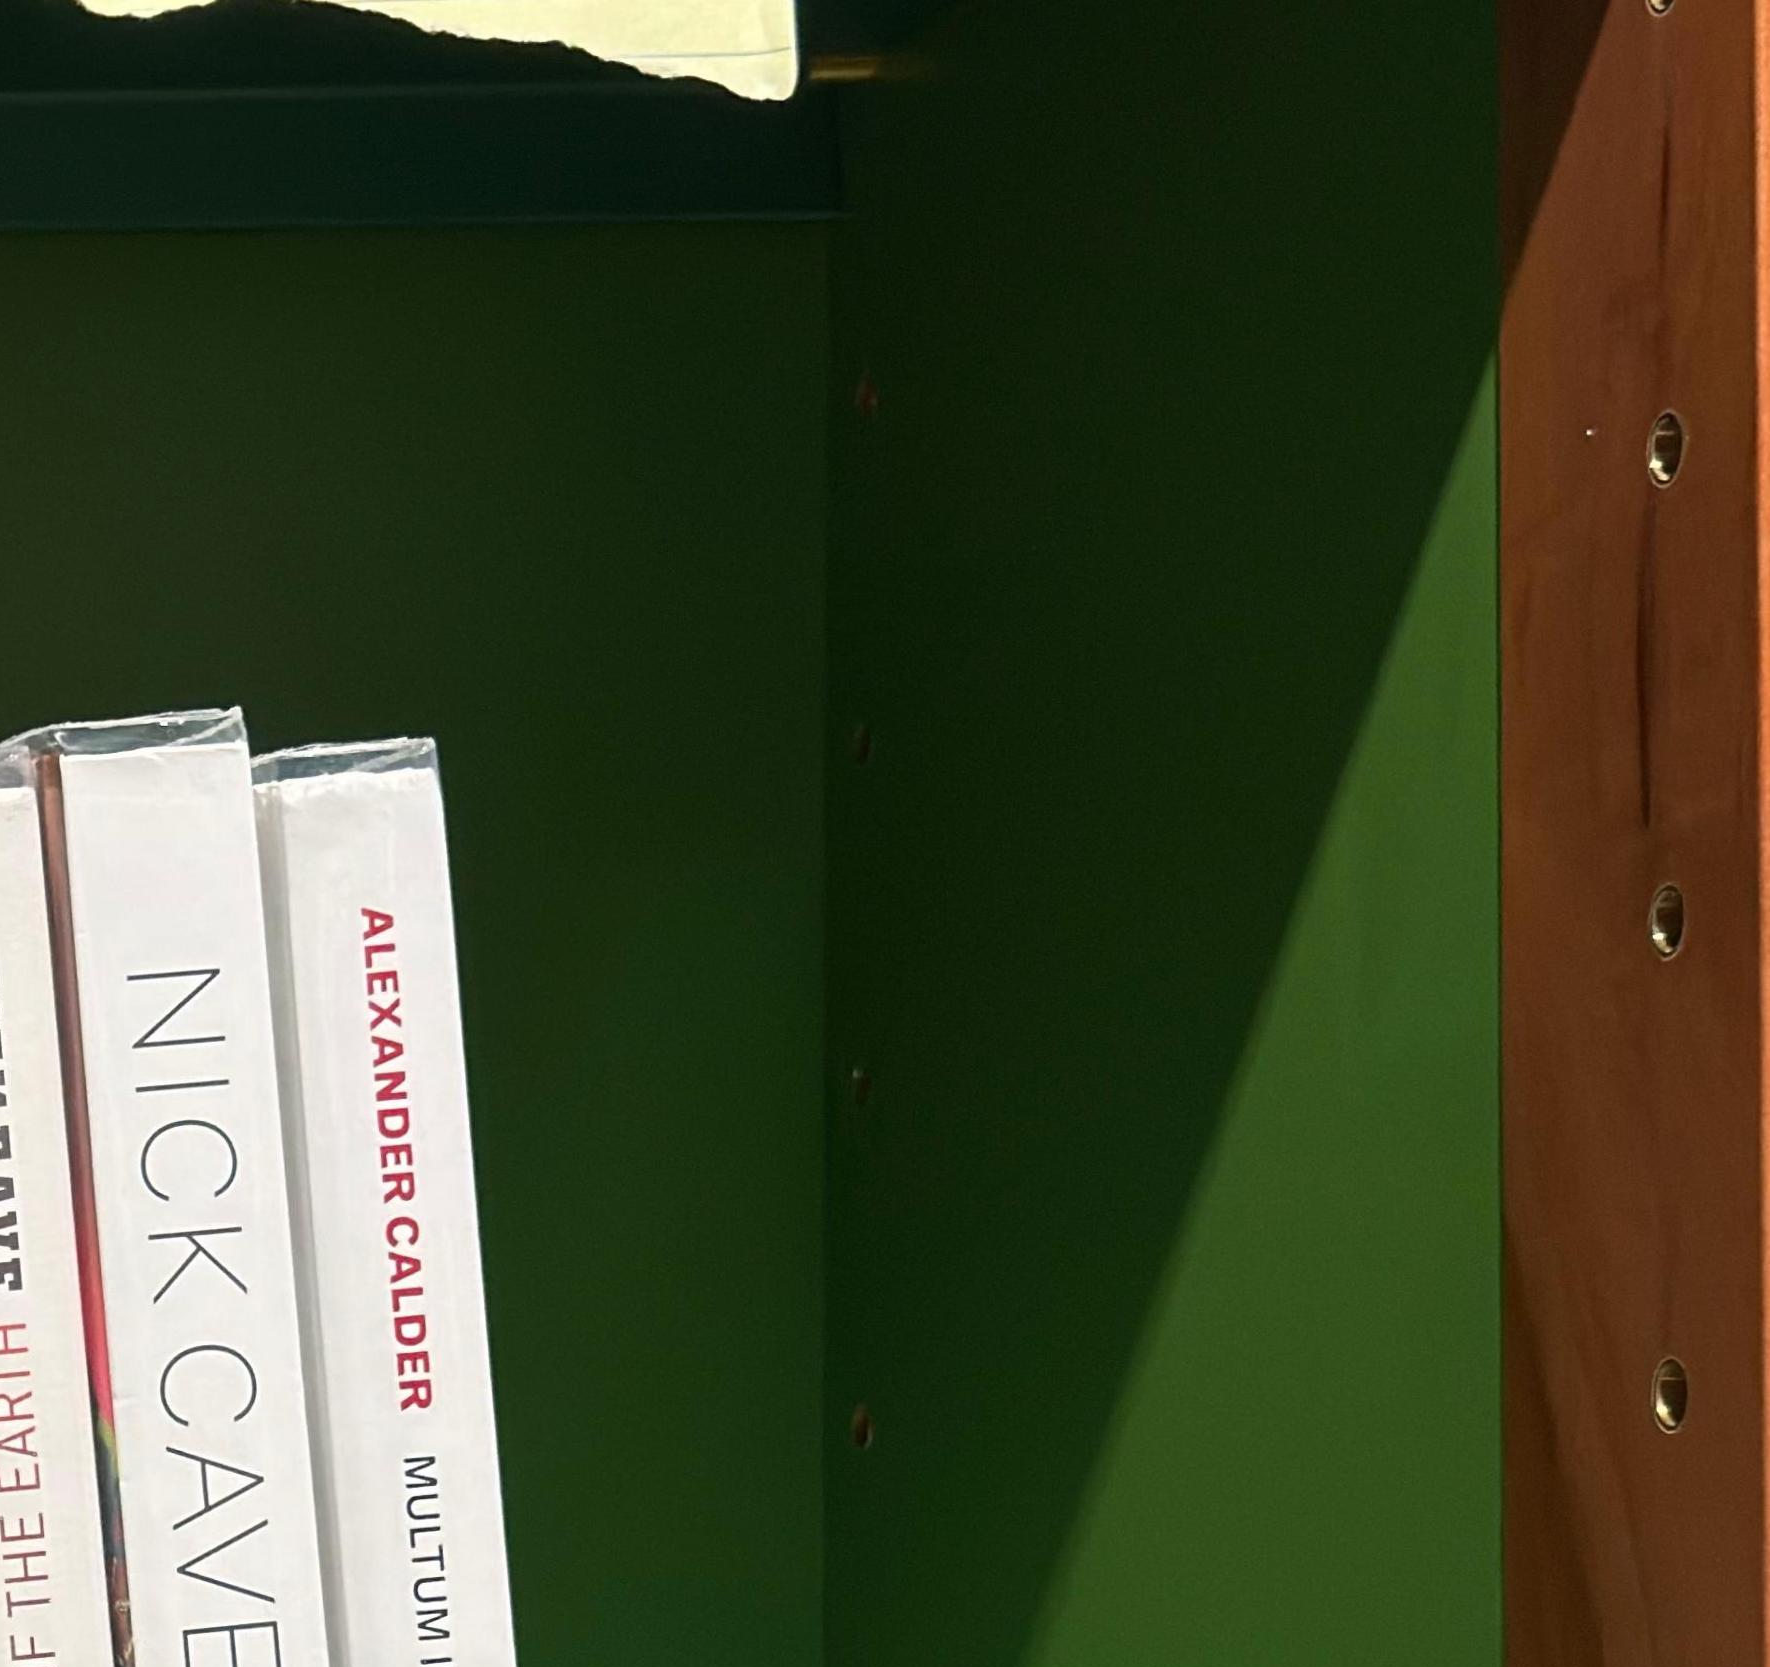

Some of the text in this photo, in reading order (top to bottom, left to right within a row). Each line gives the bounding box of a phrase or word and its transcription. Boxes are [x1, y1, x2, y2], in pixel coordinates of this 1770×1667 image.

[127, 968, 248, 1304] NICK
[361, 907, 415, 1204] ALEXANDER
[386, 1217, 432, 1412] CALDER
[0, 1512, 51, 1618] THE
[403, 1455, 450, 1641] MULTUM
